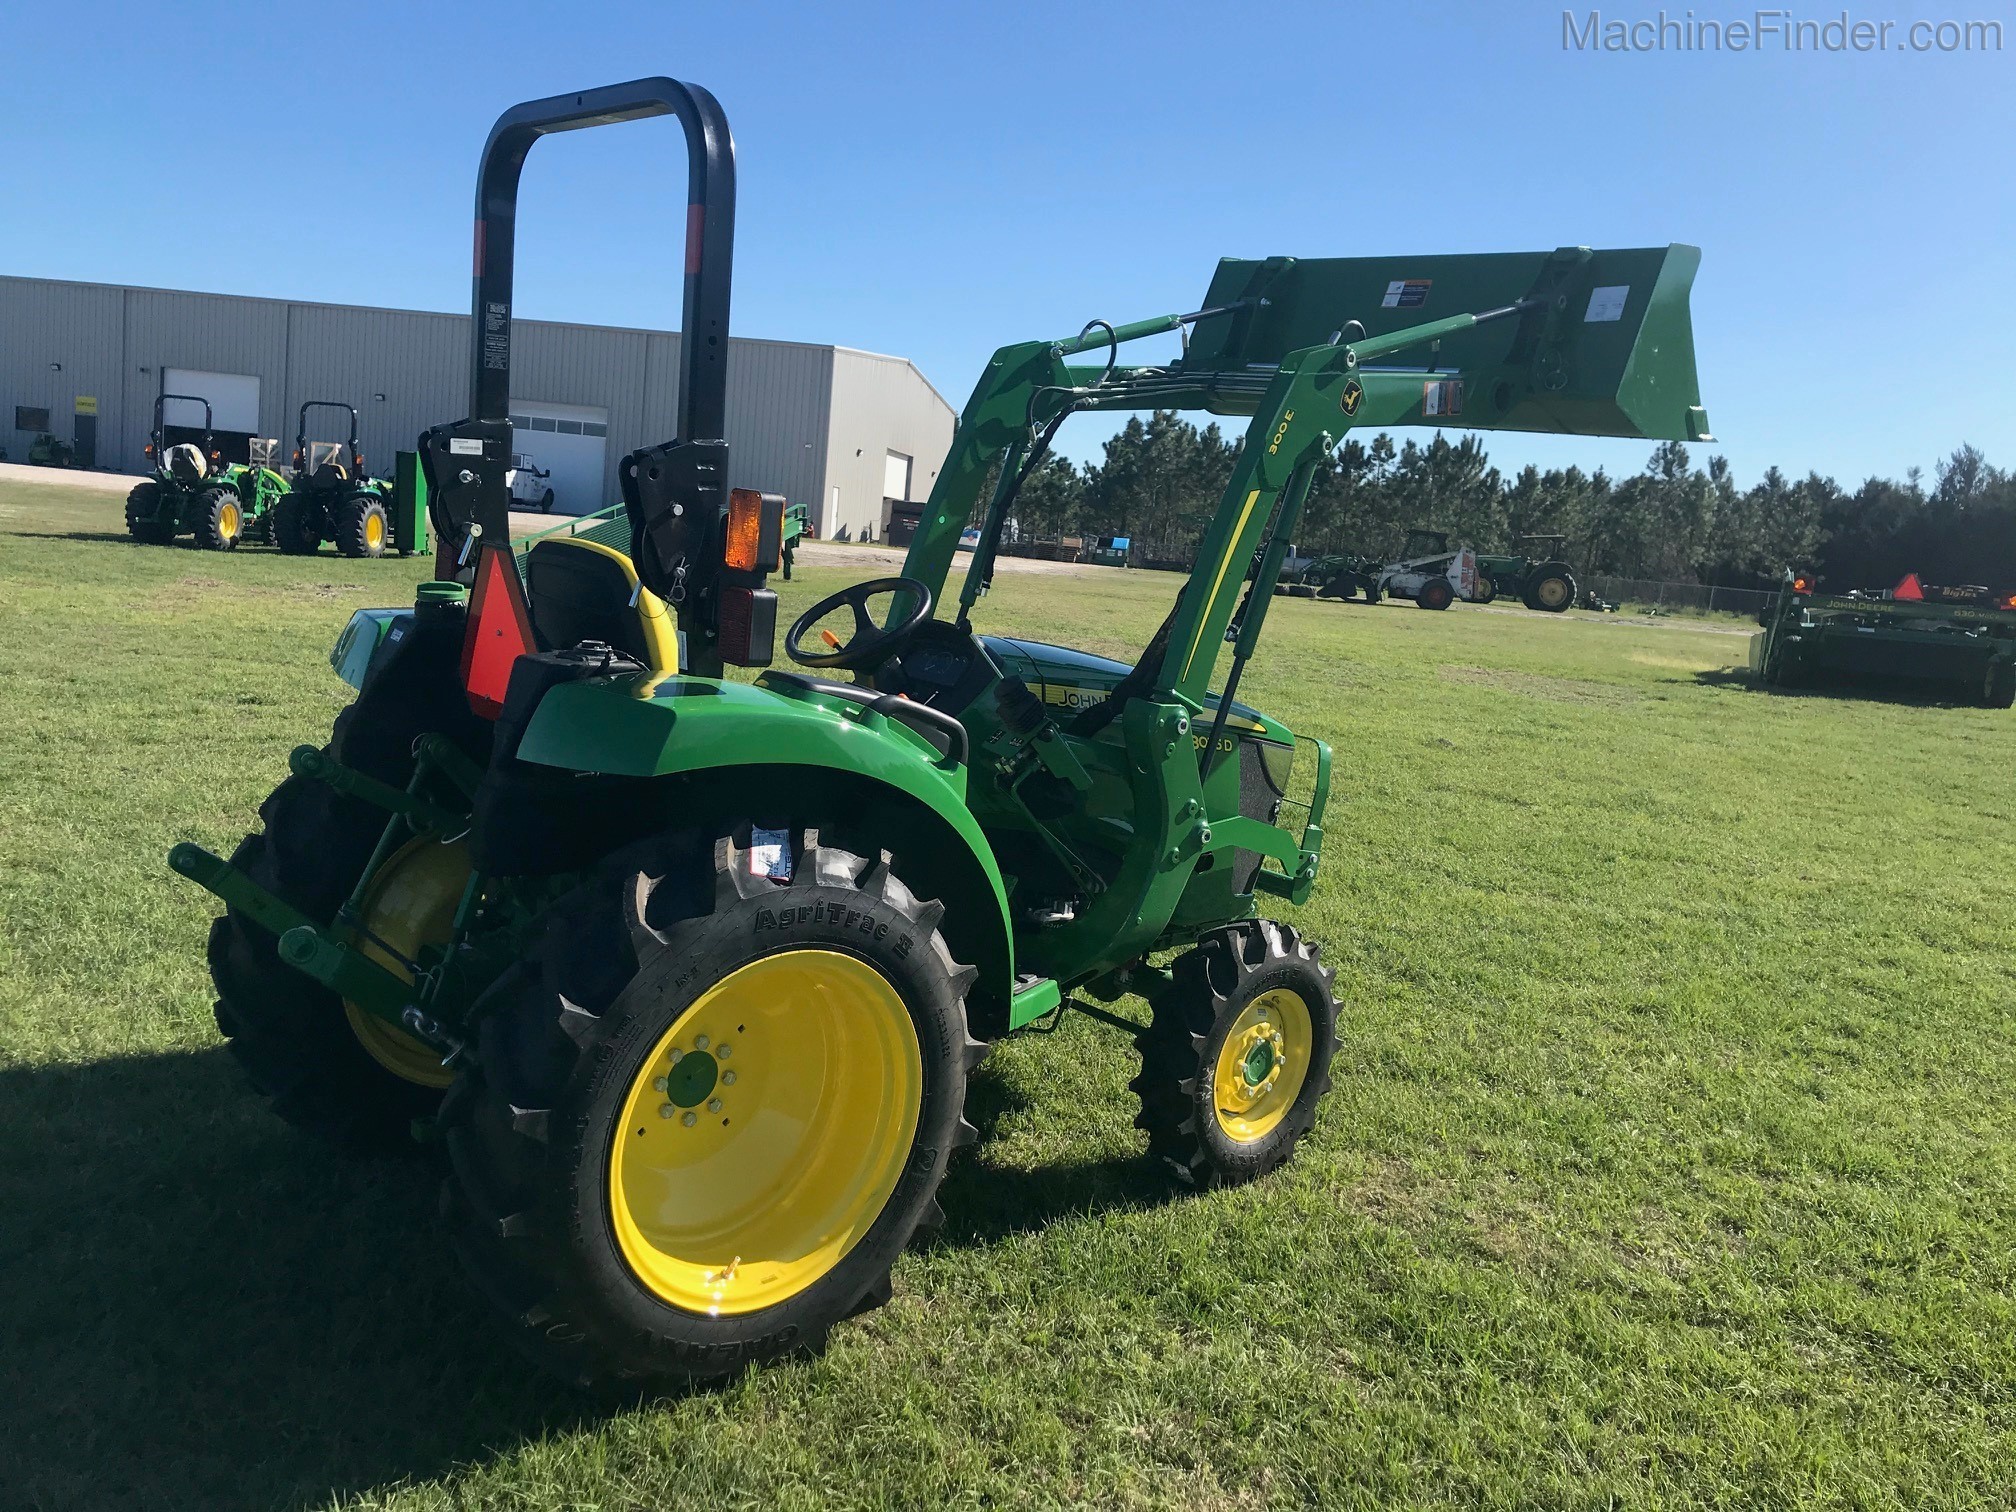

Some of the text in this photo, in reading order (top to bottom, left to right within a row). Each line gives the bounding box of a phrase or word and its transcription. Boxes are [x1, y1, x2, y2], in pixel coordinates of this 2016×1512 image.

[1268, 409, 1294, 455] 300E
[1827, 600, 1895, 612] JOHN DEERE
[1953, 609, 1975, 618] 630
[1058, 688, 1102, 707] JOHN
[754, 900, 890, 940] AgriTrac
